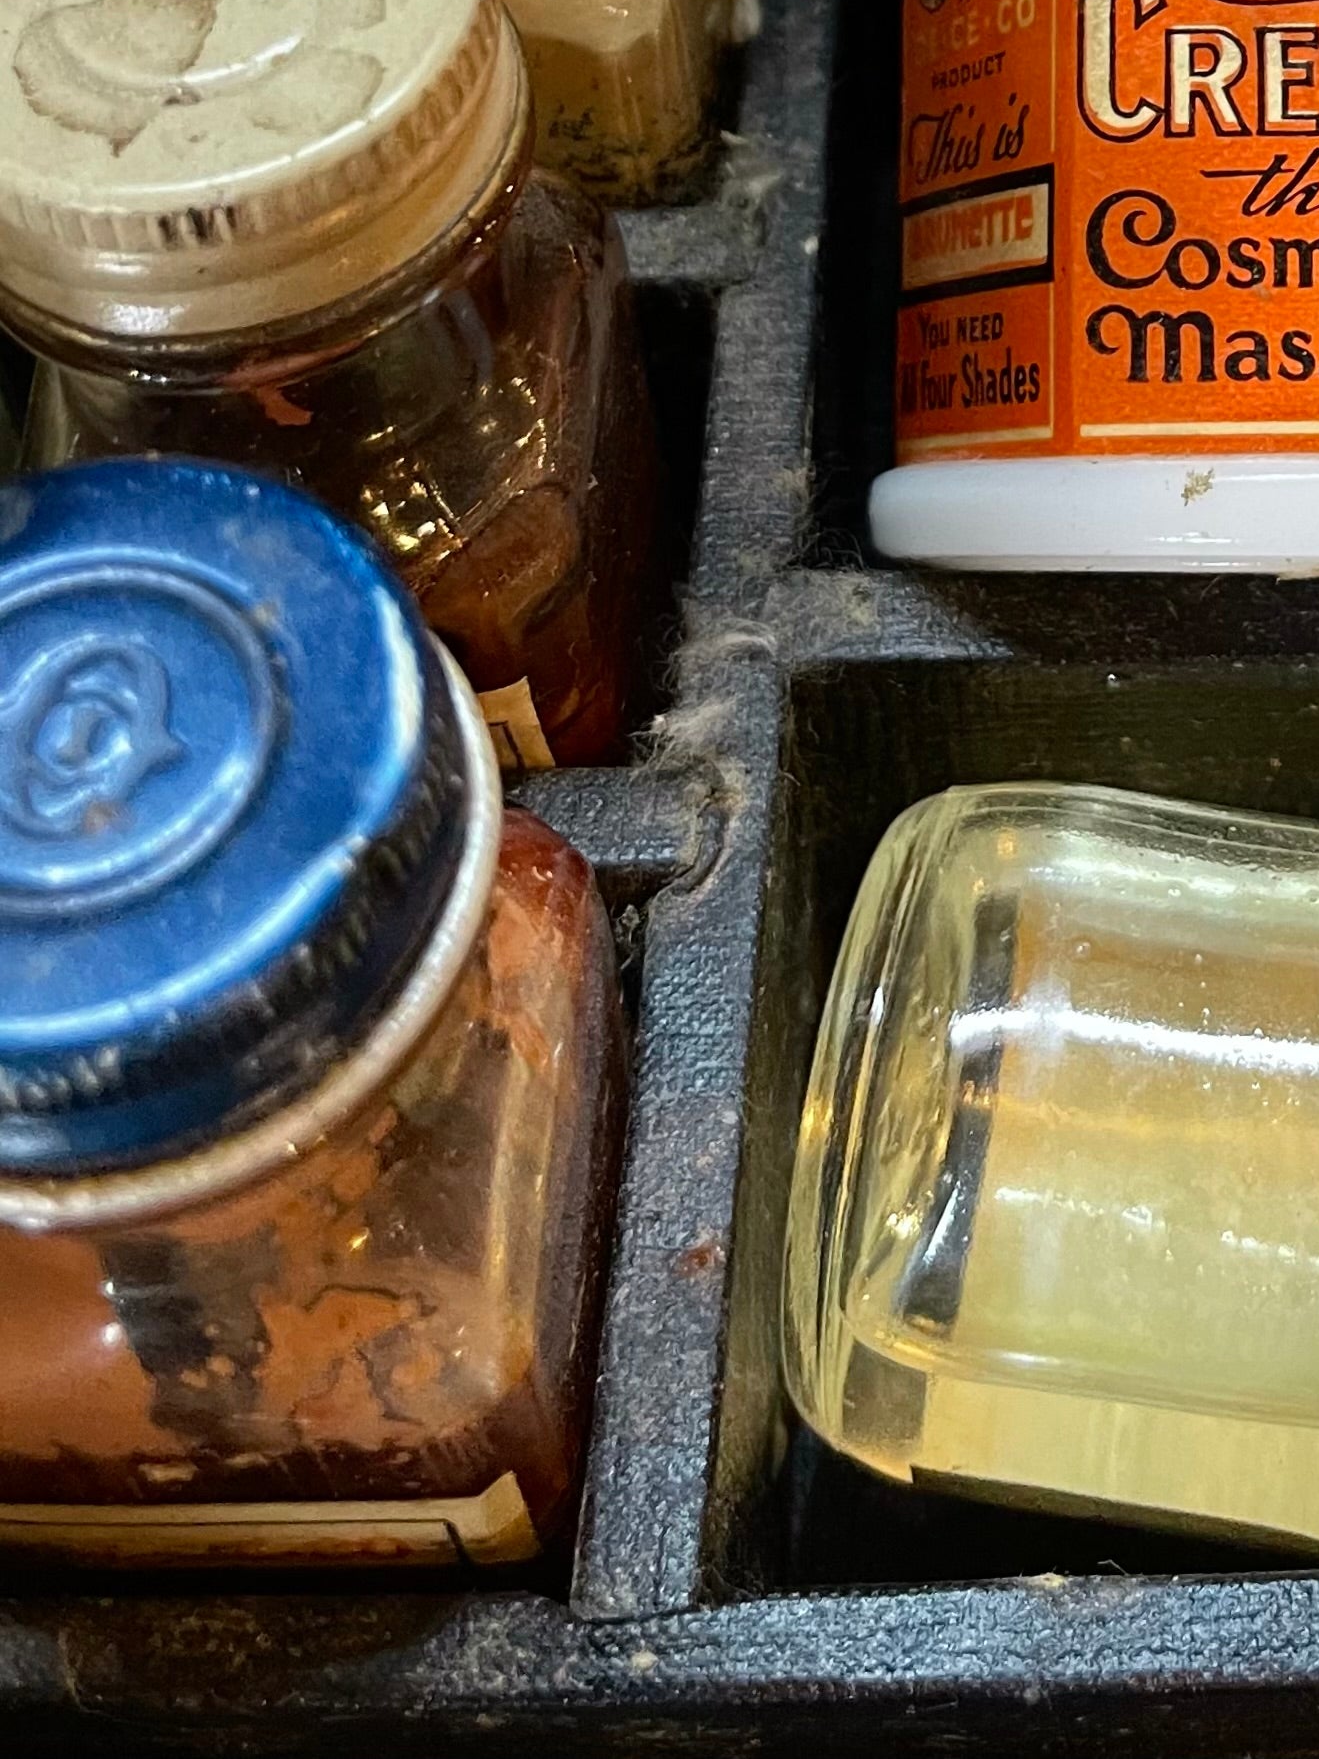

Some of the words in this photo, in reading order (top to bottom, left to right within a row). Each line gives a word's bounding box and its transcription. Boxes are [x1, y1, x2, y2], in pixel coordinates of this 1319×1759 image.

[931, 51, 1006, 91] PRODUCT
[908, 103, 986, 184] This
[993, 92, 1030, 162] is
[957, 312, 1004, 344] NEED
[961, 347, 1041, 409] Shades
